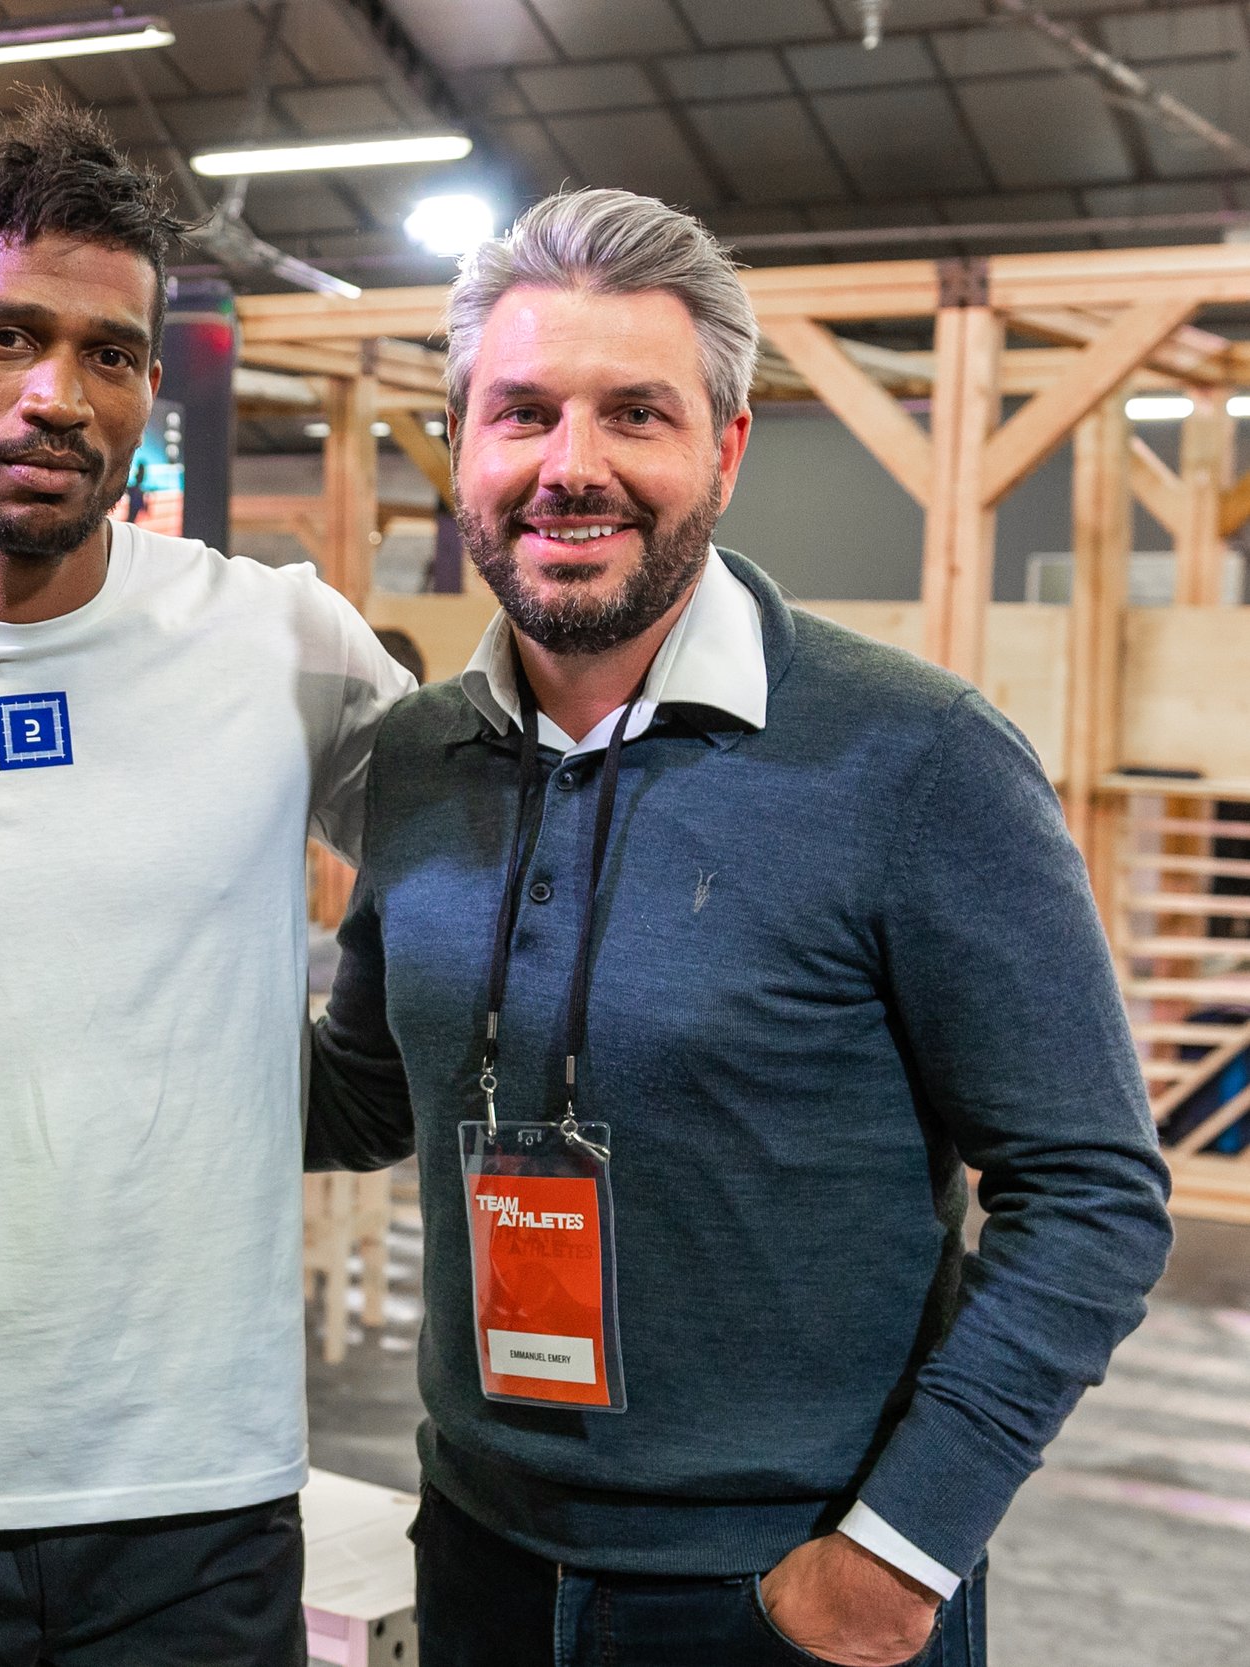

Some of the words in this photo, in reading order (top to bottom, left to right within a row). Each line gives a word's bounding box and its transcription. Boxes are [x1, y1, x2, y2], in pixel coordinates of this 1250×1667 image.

[475, 1194, 519, 1212] TEAM
[497, 1211, 585, 1230] ATHLETES
[509, 1349, 547, 1362] EMMANUEL
[547, 1353, 571, 1364] EMERY
